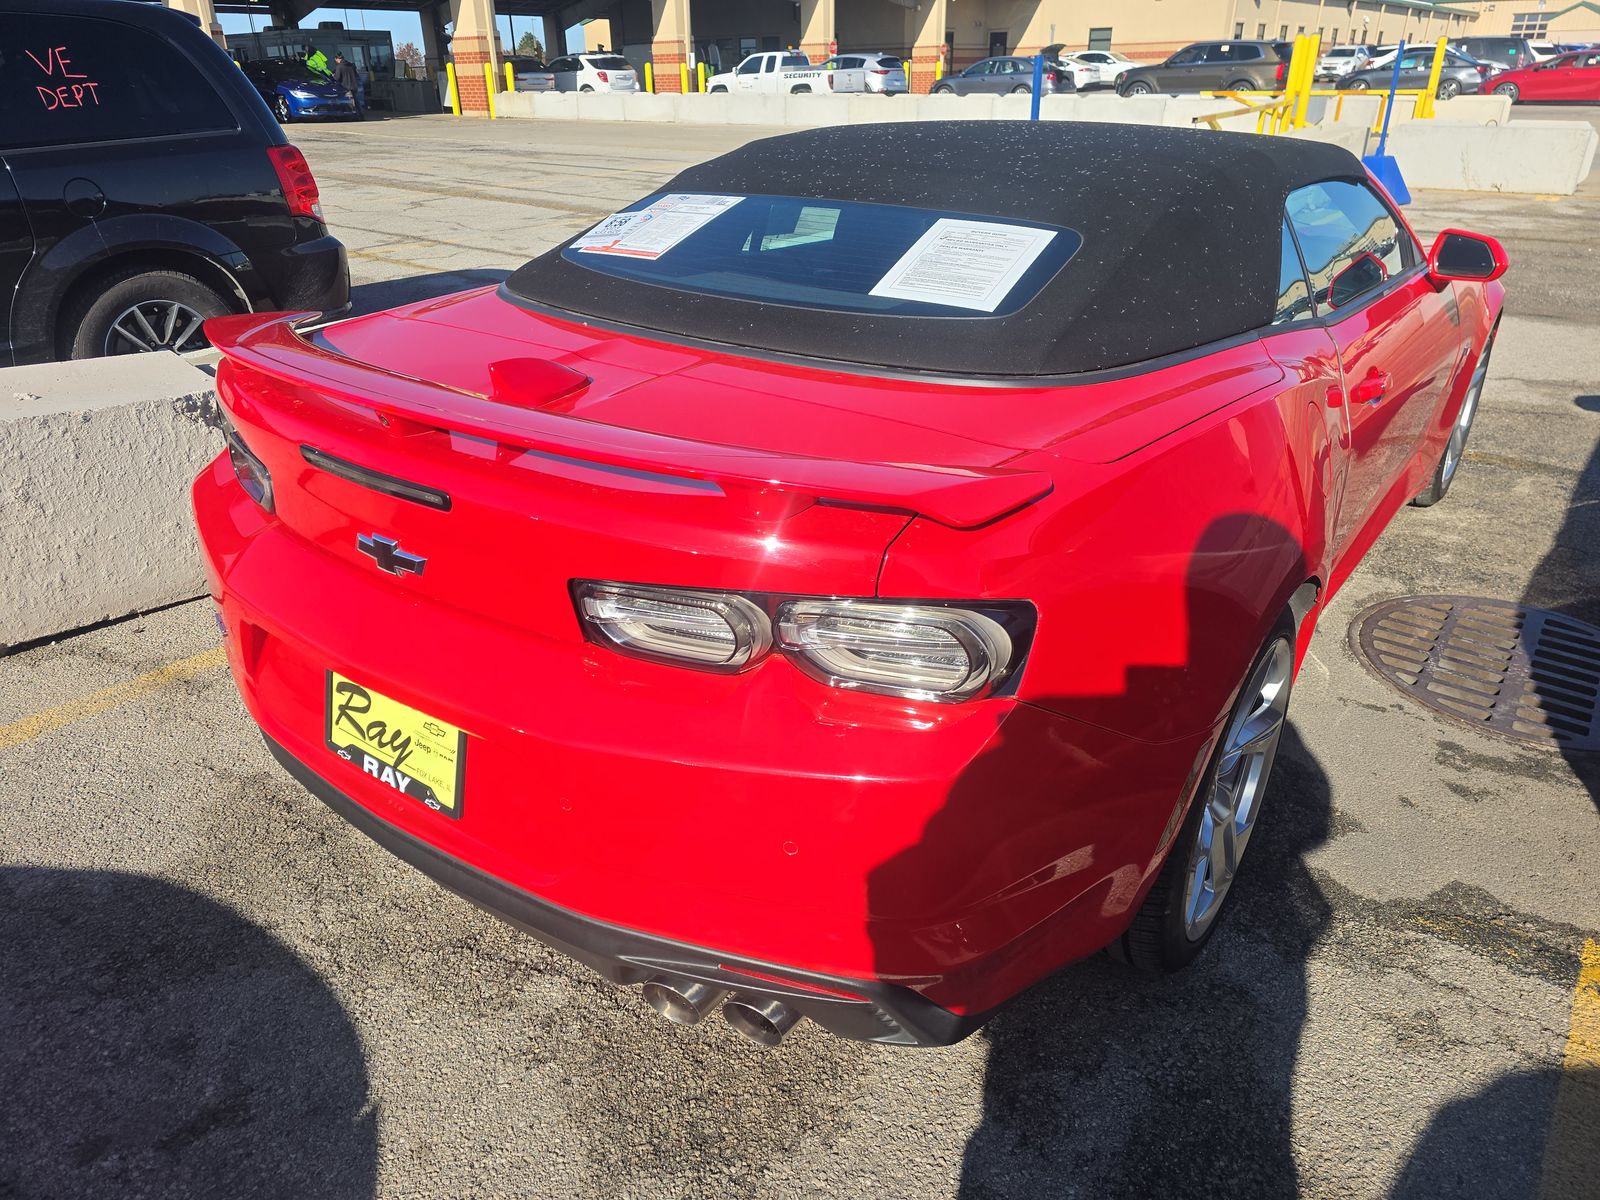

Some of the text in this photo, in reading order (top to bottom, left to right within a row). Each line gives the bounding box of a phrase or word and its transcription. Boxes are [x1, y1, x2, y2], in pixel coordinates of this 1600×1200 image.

[25, 46, 88, 78] VE
[36, 82, 99, 110] DEPT
[335, 682, 413, 769] Ray
[414, 738, 432, 754] Jeep
[363, 754, 411, 793] RAY
[416, 767, 428, 779] FOX
